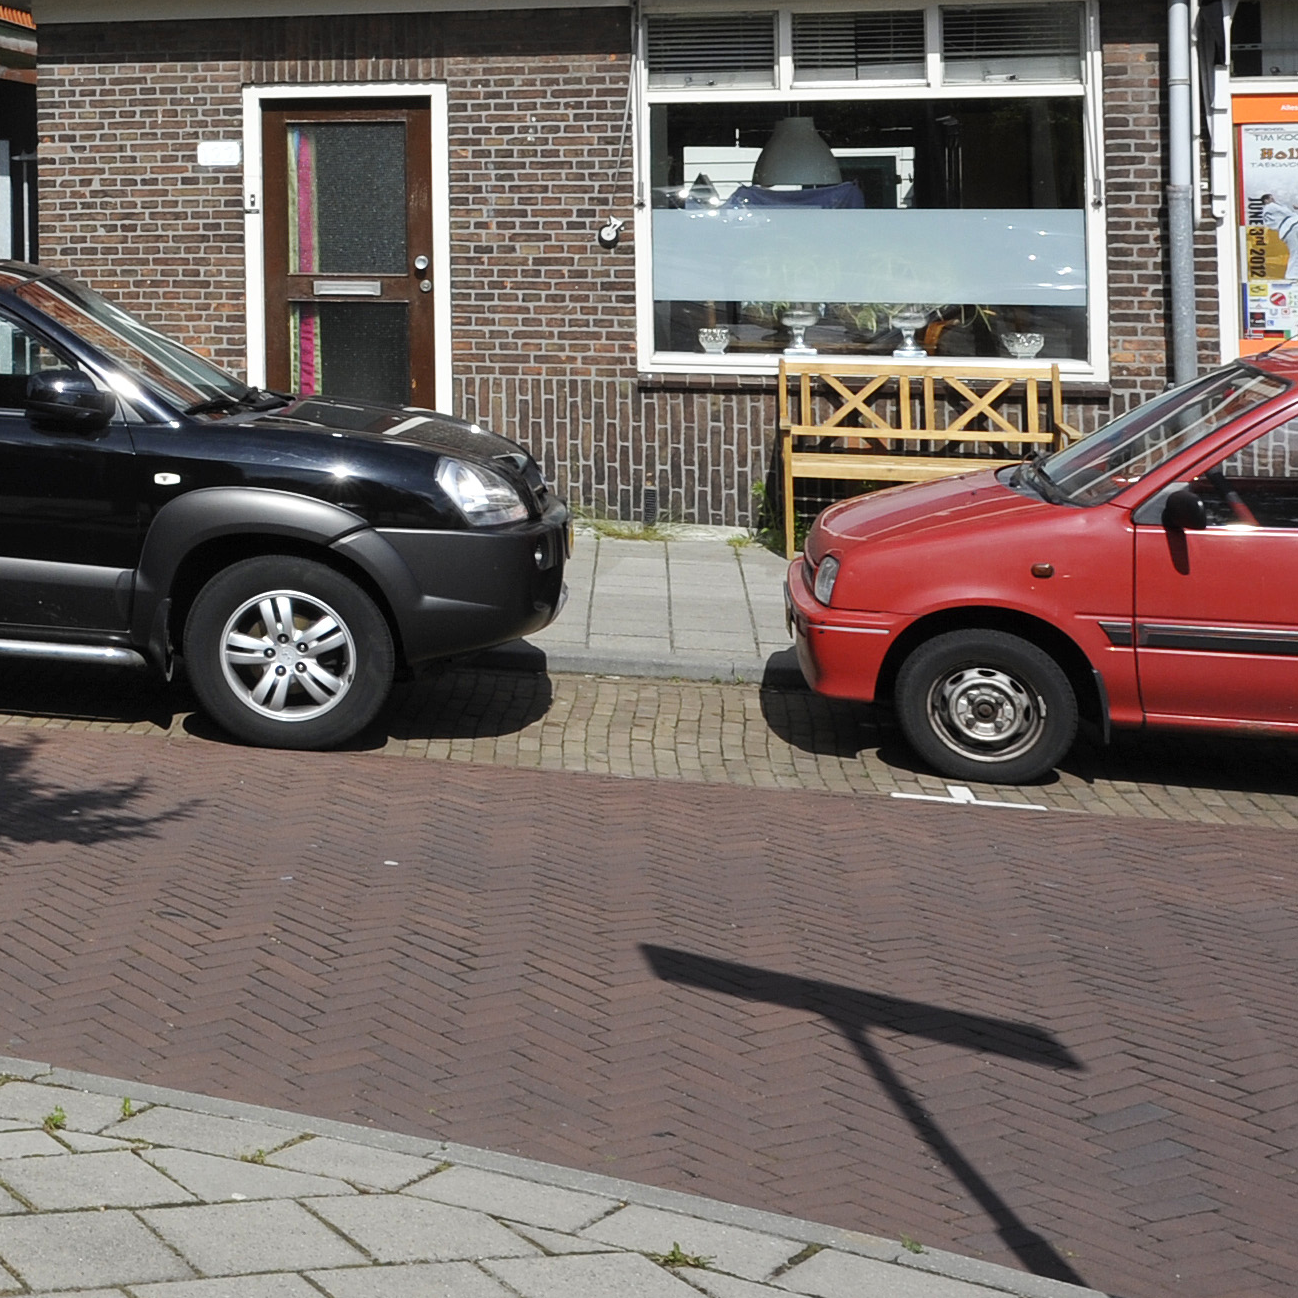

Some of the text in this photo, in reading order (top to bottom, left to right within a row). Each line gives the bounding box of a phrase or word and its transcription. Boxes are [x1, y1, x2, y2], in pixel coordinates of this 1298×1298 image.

[1247, 196, 1264, 226] JUNE
[1249, 228, 1267, 246] 3rd
[1250, 248, 1267, 278] 2012
